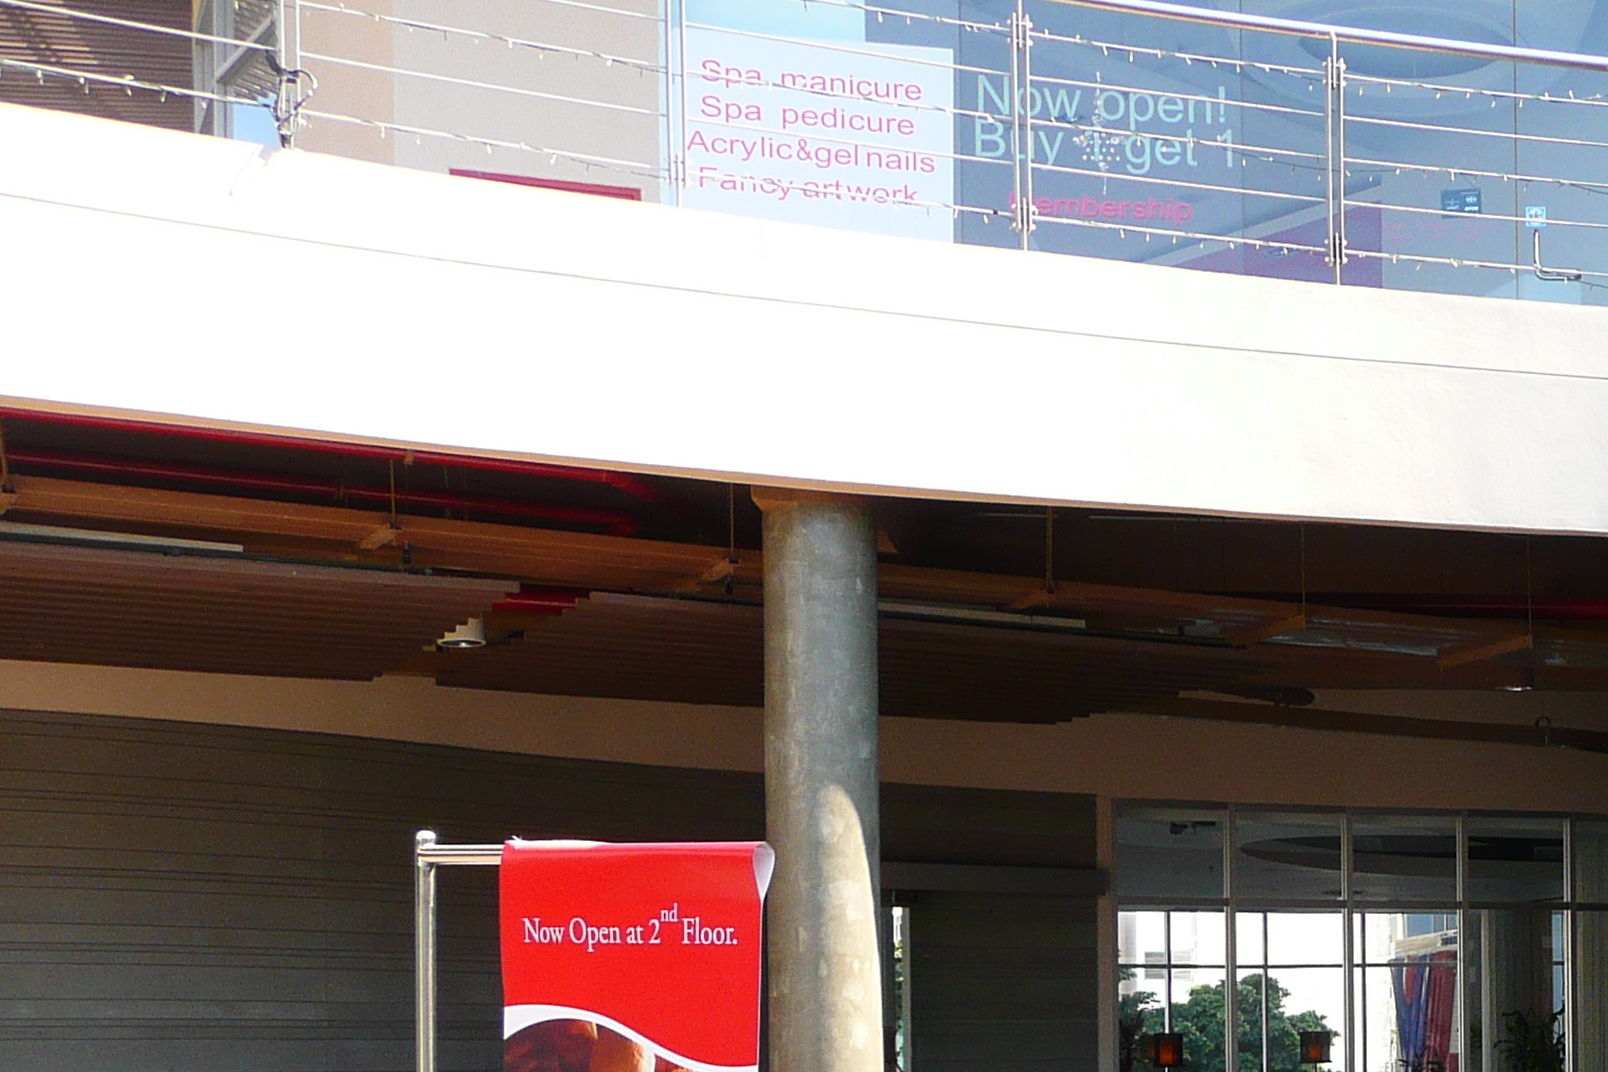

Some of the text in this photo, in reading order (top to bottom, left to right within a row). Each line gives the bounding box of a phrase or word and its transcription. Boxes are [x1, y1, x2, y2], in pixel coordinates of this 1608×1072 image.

[700, 59, 923, 102] Spa manicure
[700, 95, 916, 136] Spa pedicure
[977, 74, 1226, 131] Now open!
[866, 150, 936, 174] nails
[974, 116, 1065, 166] Buy
[1125, 128, 1198, 176] get
[698, 166, 919, 205] Fancy artwork
[1009, 190, 1194, 225] embership
[522, 902, 739, 953] Now Open at 2nd Floor.
